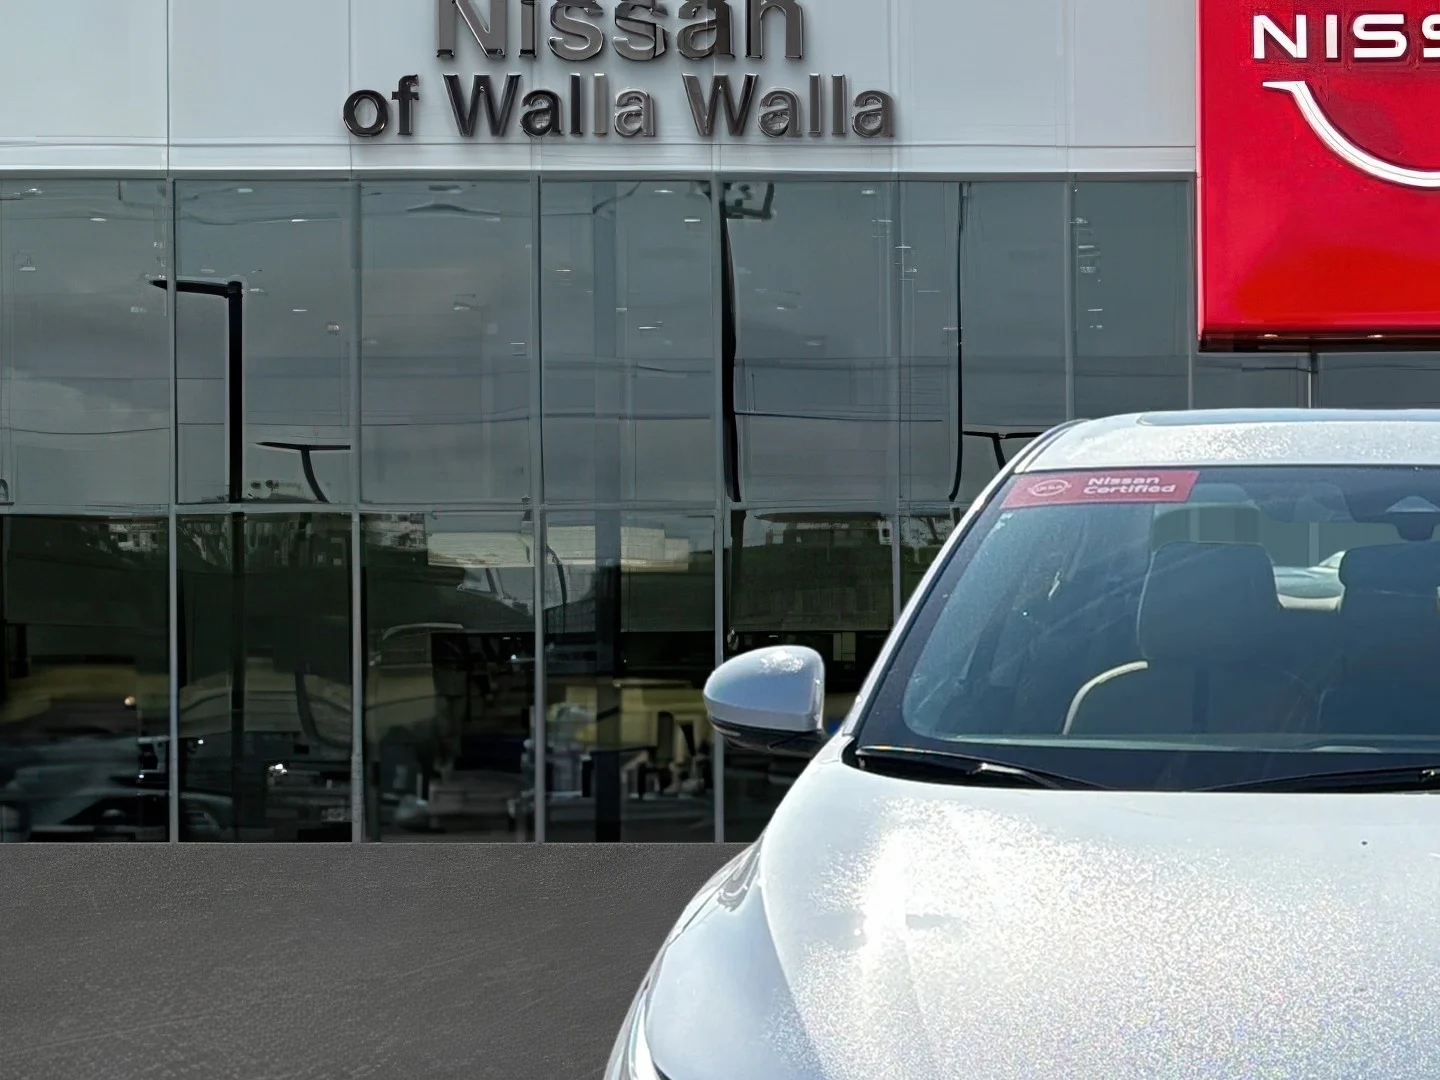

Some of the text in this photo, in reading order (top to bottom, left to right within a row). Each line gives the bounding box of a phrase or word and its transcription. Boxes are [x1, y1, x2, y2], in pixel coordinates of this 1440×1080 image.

[437, 0, 803, 60] Nissan
[342, 72, 895, 138] of Walla Walla
[1083, 483, 1177, 495] Certified
[1087, 476, 1161, 486] Nissan
